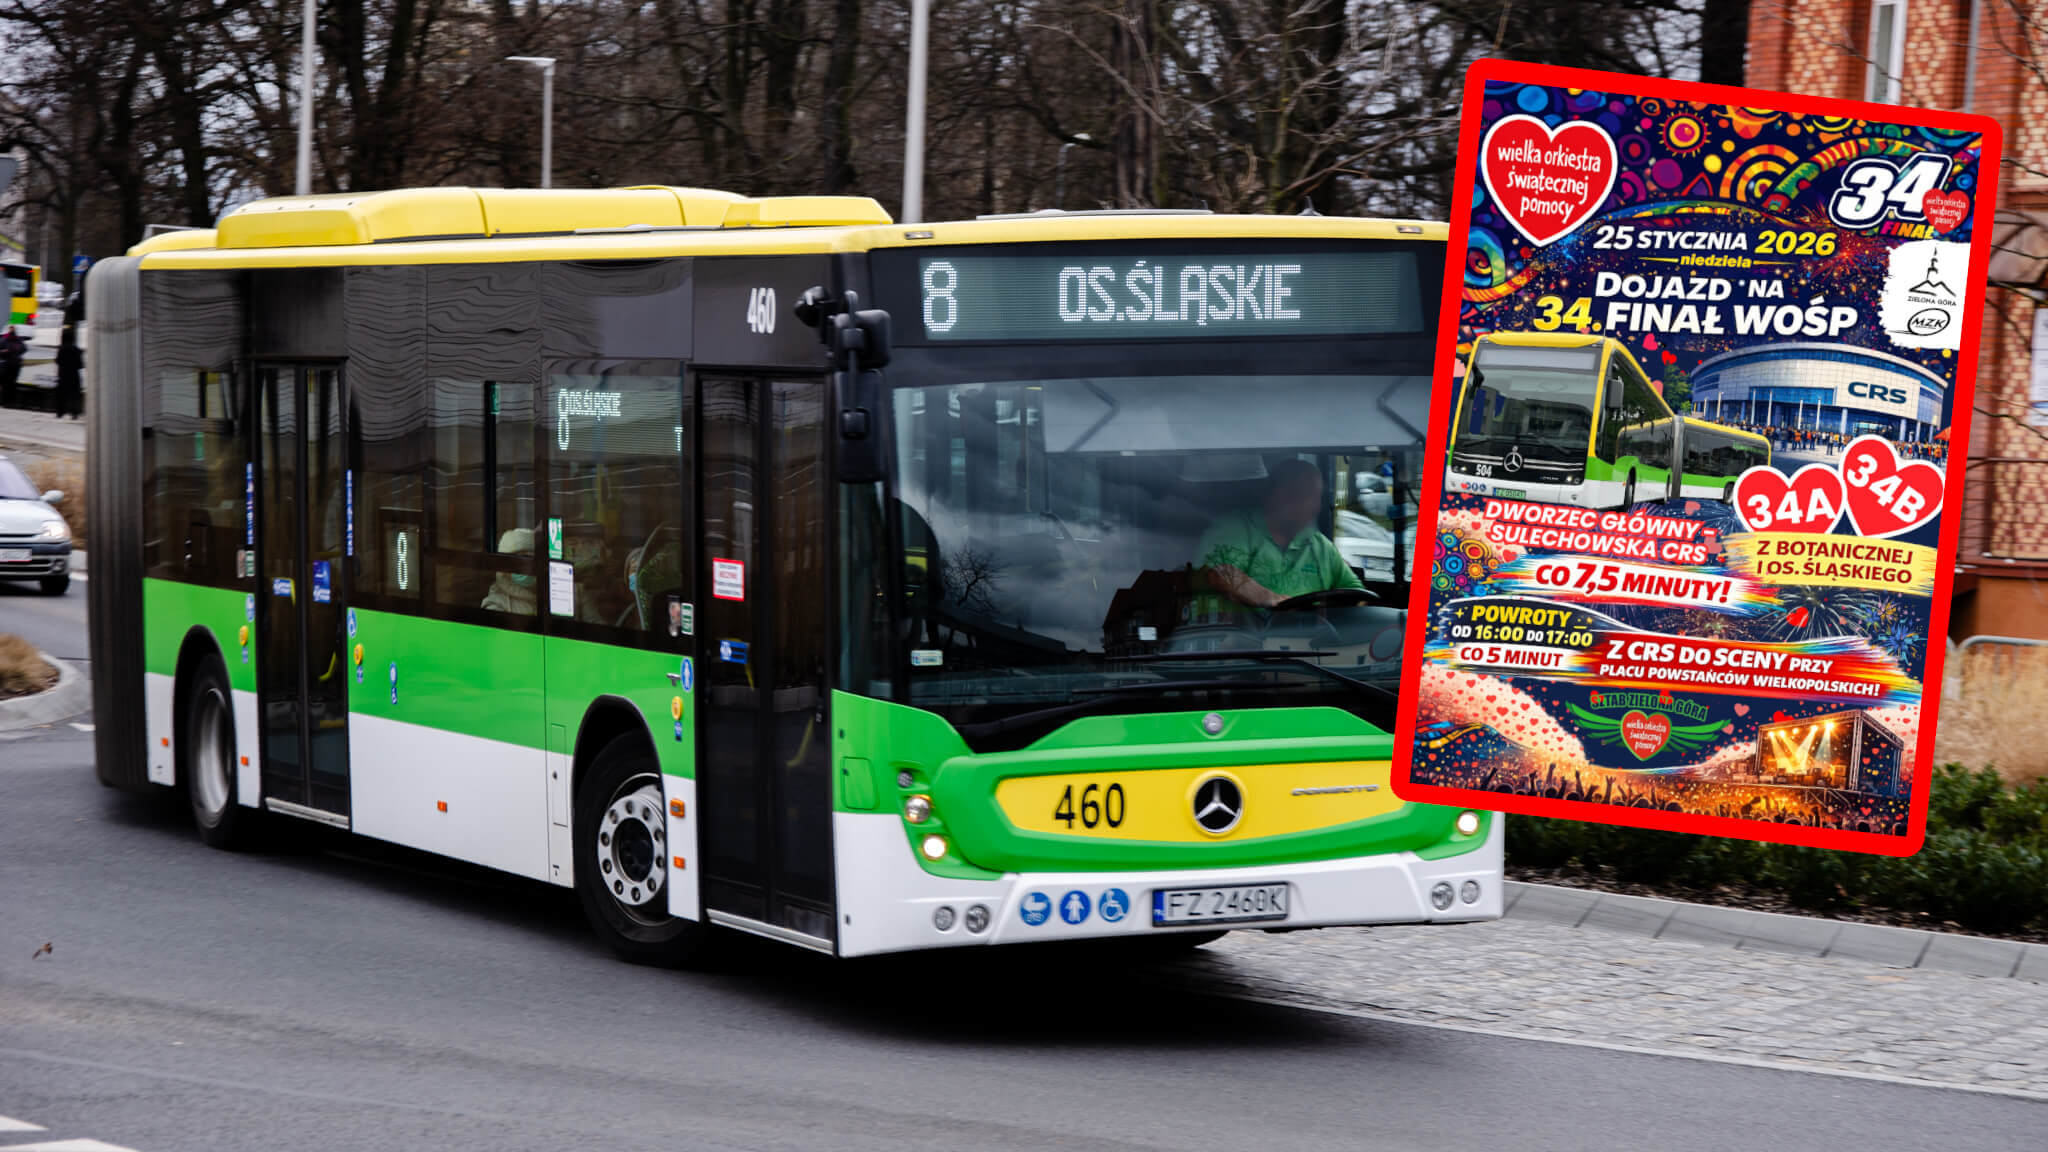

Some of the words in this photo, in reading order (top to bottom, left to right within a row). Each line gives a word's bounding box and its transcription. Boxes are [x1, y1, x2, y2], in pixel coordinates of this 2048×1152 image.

[747, 287, 776, 333] 460
[923, 260, 958, 332] 8
[1058, 260, 1301, 326] OS.ŚLĄSKIE
[398, 532, 408, 590] 8
[1055, 783, 1124, 829] 460
[1168, 892, 1203, 917] FZ
[1212, 887, 1284, 914] 2460K
